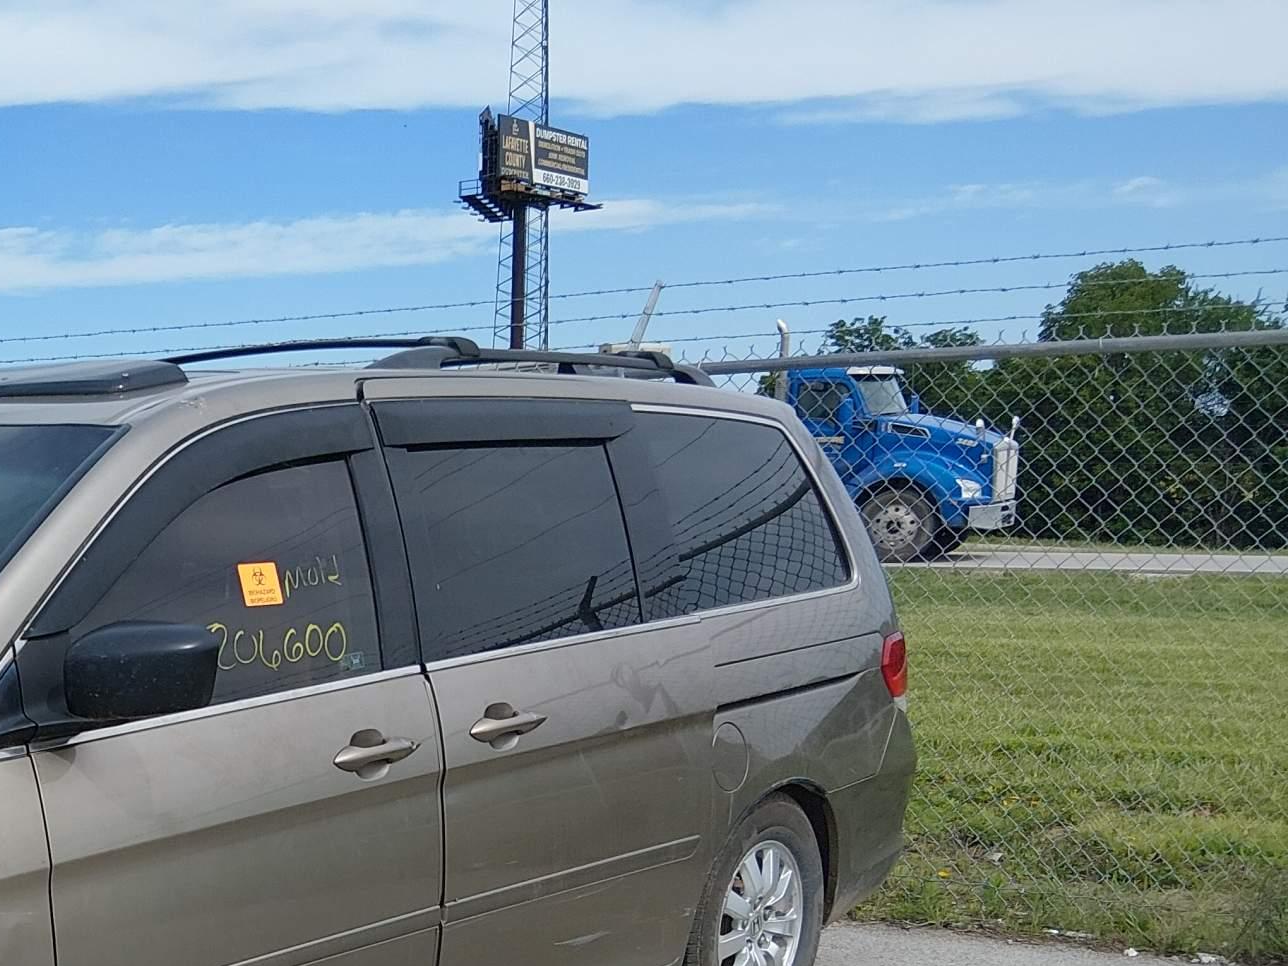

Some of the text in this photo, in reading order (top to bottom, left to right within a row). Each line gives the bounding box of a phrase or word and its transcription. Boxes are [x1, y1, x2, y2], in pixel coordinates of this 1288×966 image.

[536, 127, 567, 144] DUMPSTER
[567, 136, 587, 150] RENTAL
[505, 151, 526, 169] COUNTY
[206, 621, 347, 671] 206600
